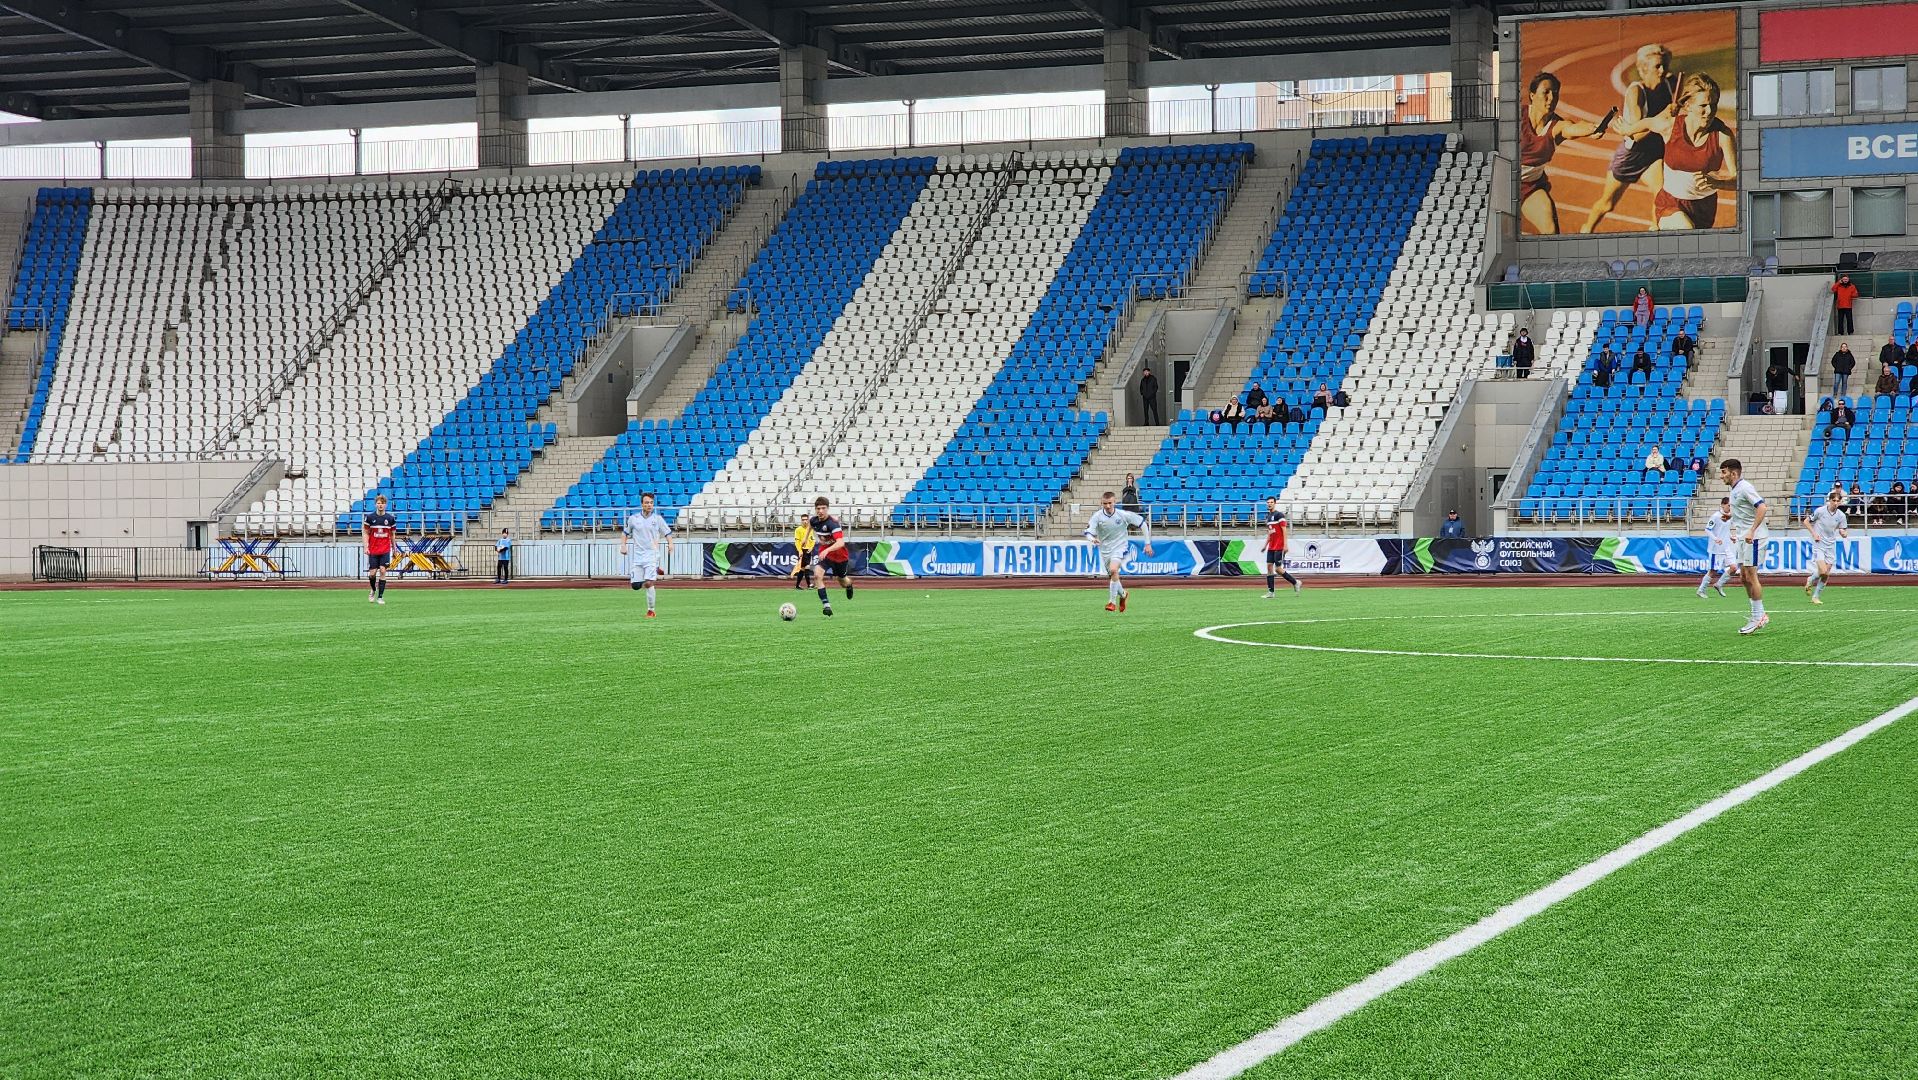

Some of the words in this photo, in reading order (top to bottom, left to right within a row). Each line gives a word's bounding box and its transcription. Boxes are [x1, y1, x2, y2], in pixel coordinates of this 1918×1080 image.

[1848, 134, 1918, 160] ВСЕ
[1500, 541, 1552, 549] РОССИЙСКИЙ
[993, 545, 1100, 573] ГАЗПРОМ
[1500, 549, 1555, 558] ФУТБОЛЬНЫЙ
[937, 562, 976, 574] ГАЗПРОМ
[1138, 562, 1178, 574] ГАЗПРОМ
[1500, 559, 1522, 567] СОЮЗ
